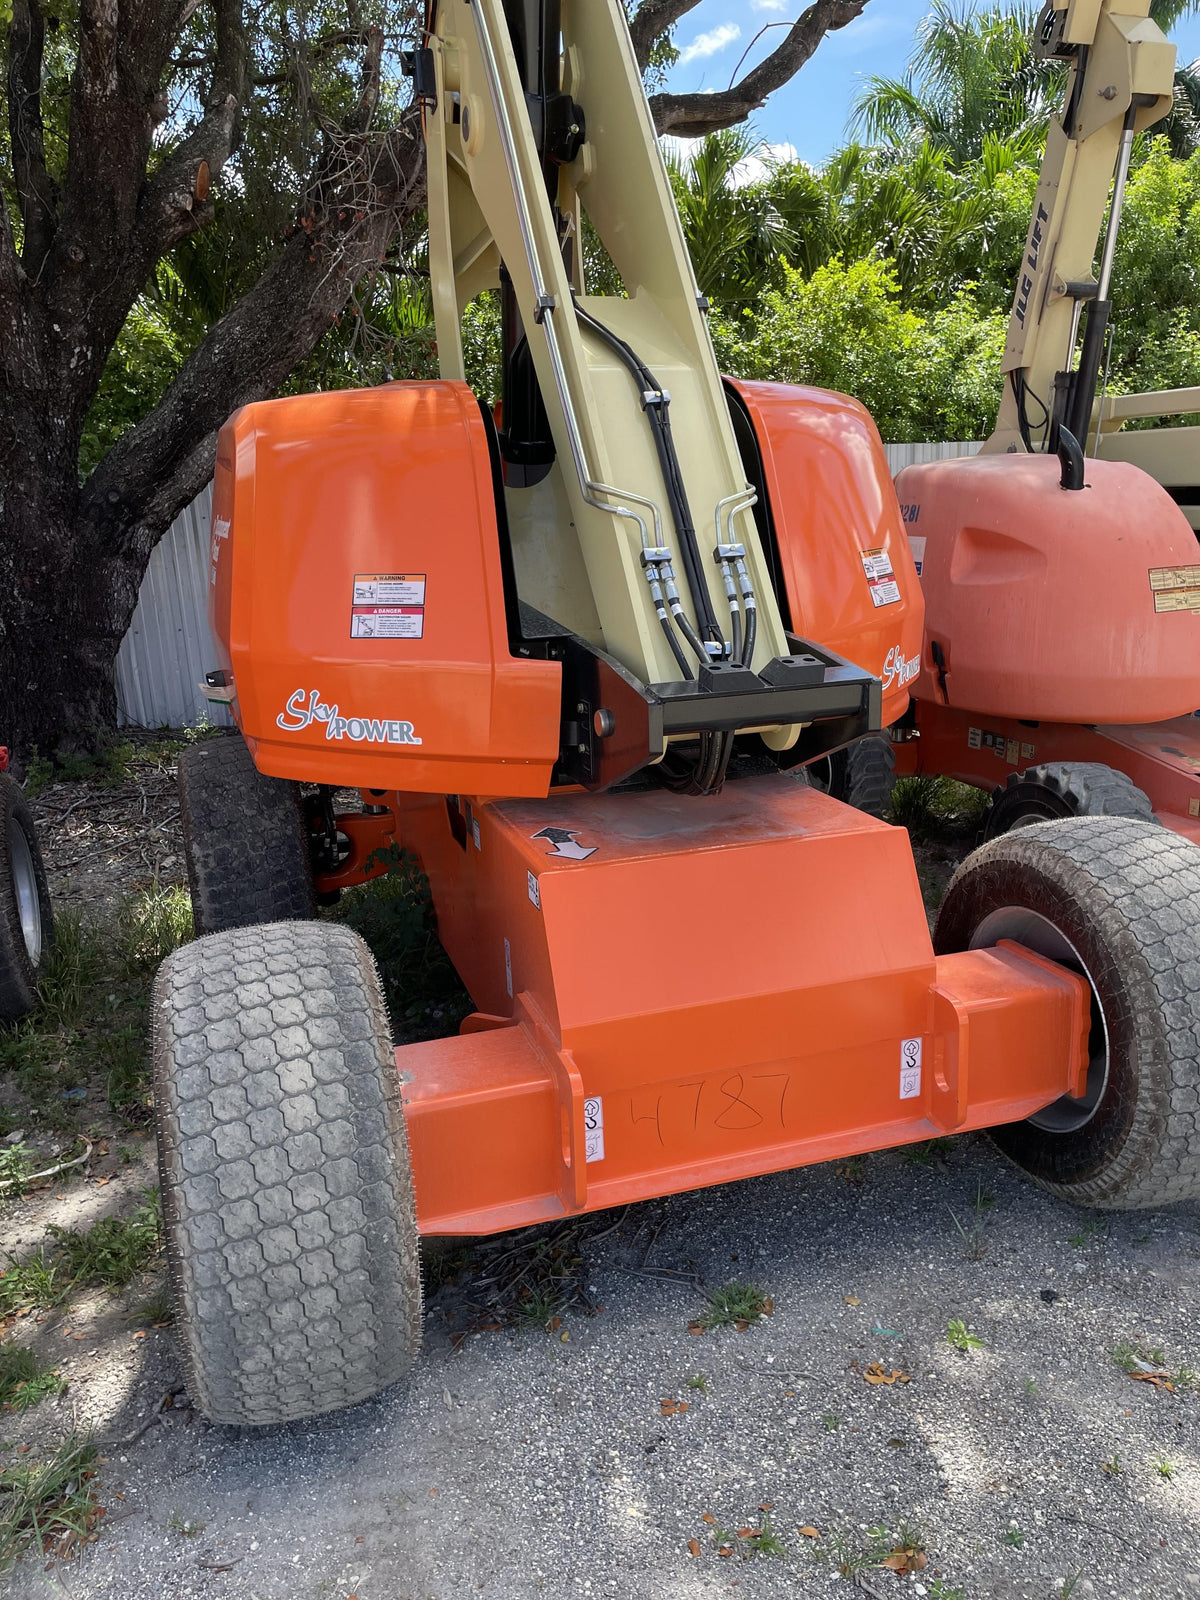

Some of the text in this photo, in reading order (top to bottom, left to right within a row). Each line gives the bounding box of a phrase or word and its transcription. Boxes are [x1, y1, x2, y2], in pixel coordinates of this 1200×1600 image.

[1015, 202, 1048, 330] JLG LIFT
[276, 689, 418, 744] Sky POWER
[630, 1072, 790, 1147] 4787
